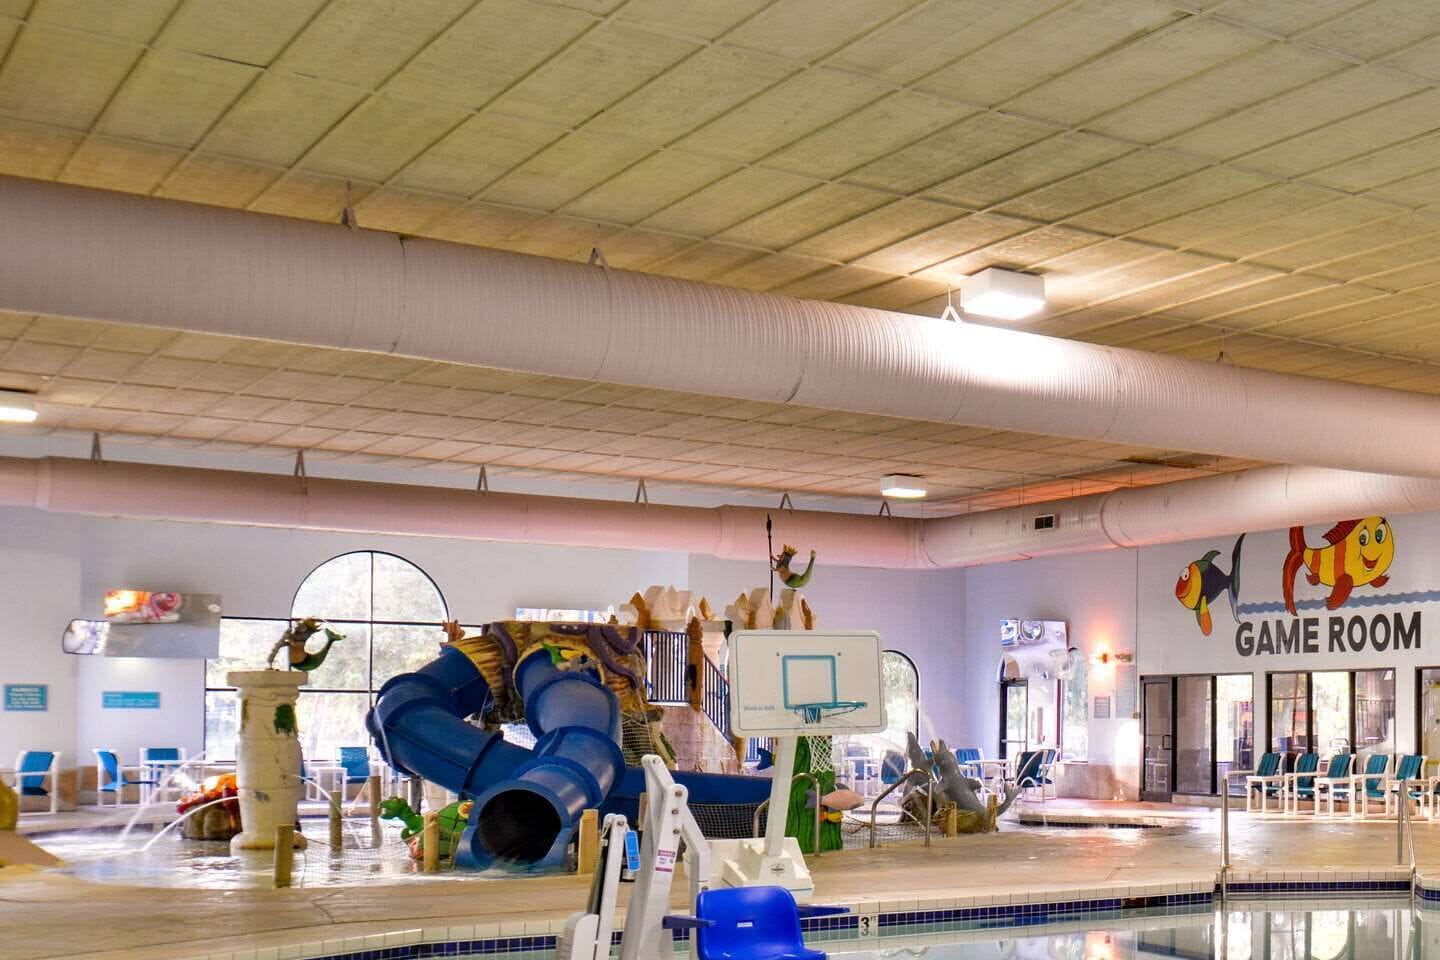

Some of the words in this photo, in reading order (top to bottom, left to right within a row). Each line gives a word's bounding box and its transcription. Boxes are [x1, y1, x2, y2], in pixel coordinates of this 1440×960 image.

[1235, 617, 1320, 657] GAME
[1328, 611, 1421, 652] ROOM
[861, 916, 870, 928] 3
